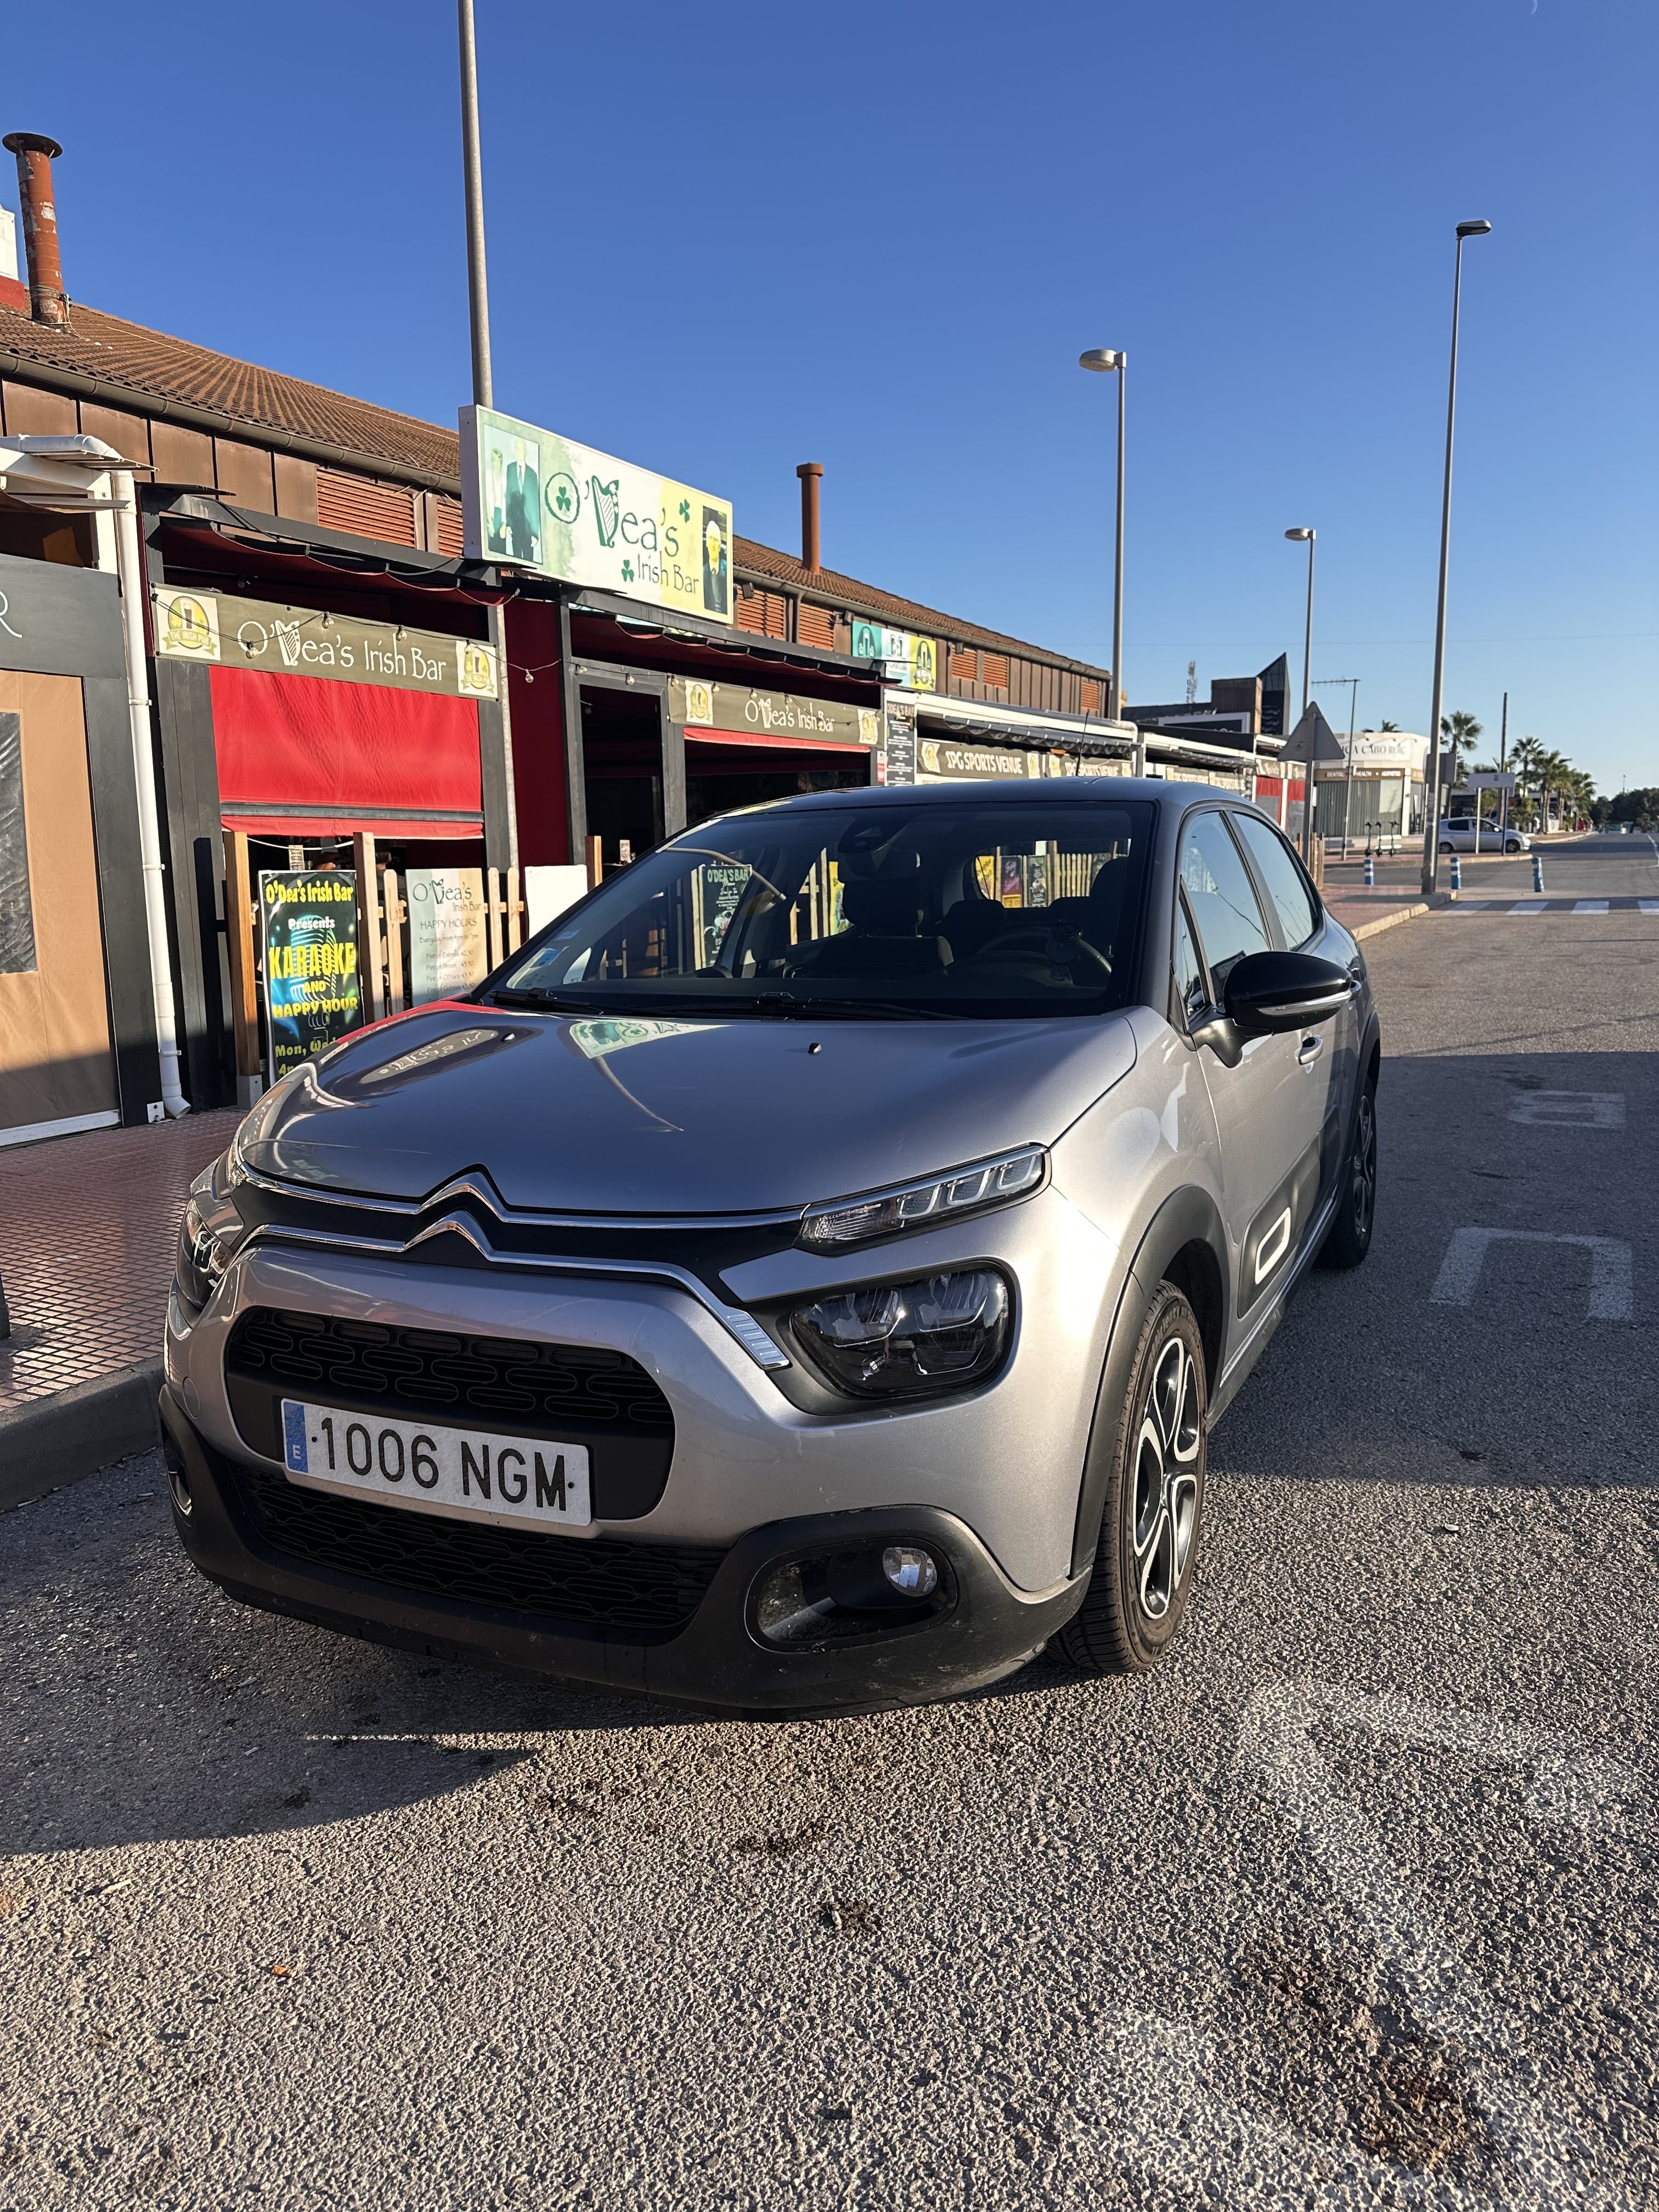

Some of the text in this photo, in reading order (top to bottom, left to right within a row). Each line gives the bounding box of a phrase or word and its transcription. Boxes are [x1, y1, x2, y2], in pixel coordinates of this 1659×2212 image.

[637, 550, 699, 594] Irish Bar
[170, 631, 182, 641] THE
[198, 634, 209, 646] PUB
[364, 633, 407, 675] Irish
[411, 646, 447, 681] Bar
[798, 702, 817, 730] Irish
[817, 710, 835, 732] Bar
[963, 751, 996, 772] SPORTS
[996, 755, 1023, 775] VENUE
[735, 868, 749, 882] BAR
[266, 879, 354, 904] O'Dea's Irish Bar
[453, 898, 482, 912] Irish Bar
[288, 916, 335, 930] Presents
[420, 917, 477, 930] HAPPY HOURS
[269, 942, 356, 979] KARAOKE
[303, 980, 326, 993] AND
[272, 997, 358, 1019] HAPPY HOUR
[275, 1045, 307, 1058] Mon,
[292, 1444, 302, 1460] E
[321, 1417, 567, 1512] 1006 NGM
